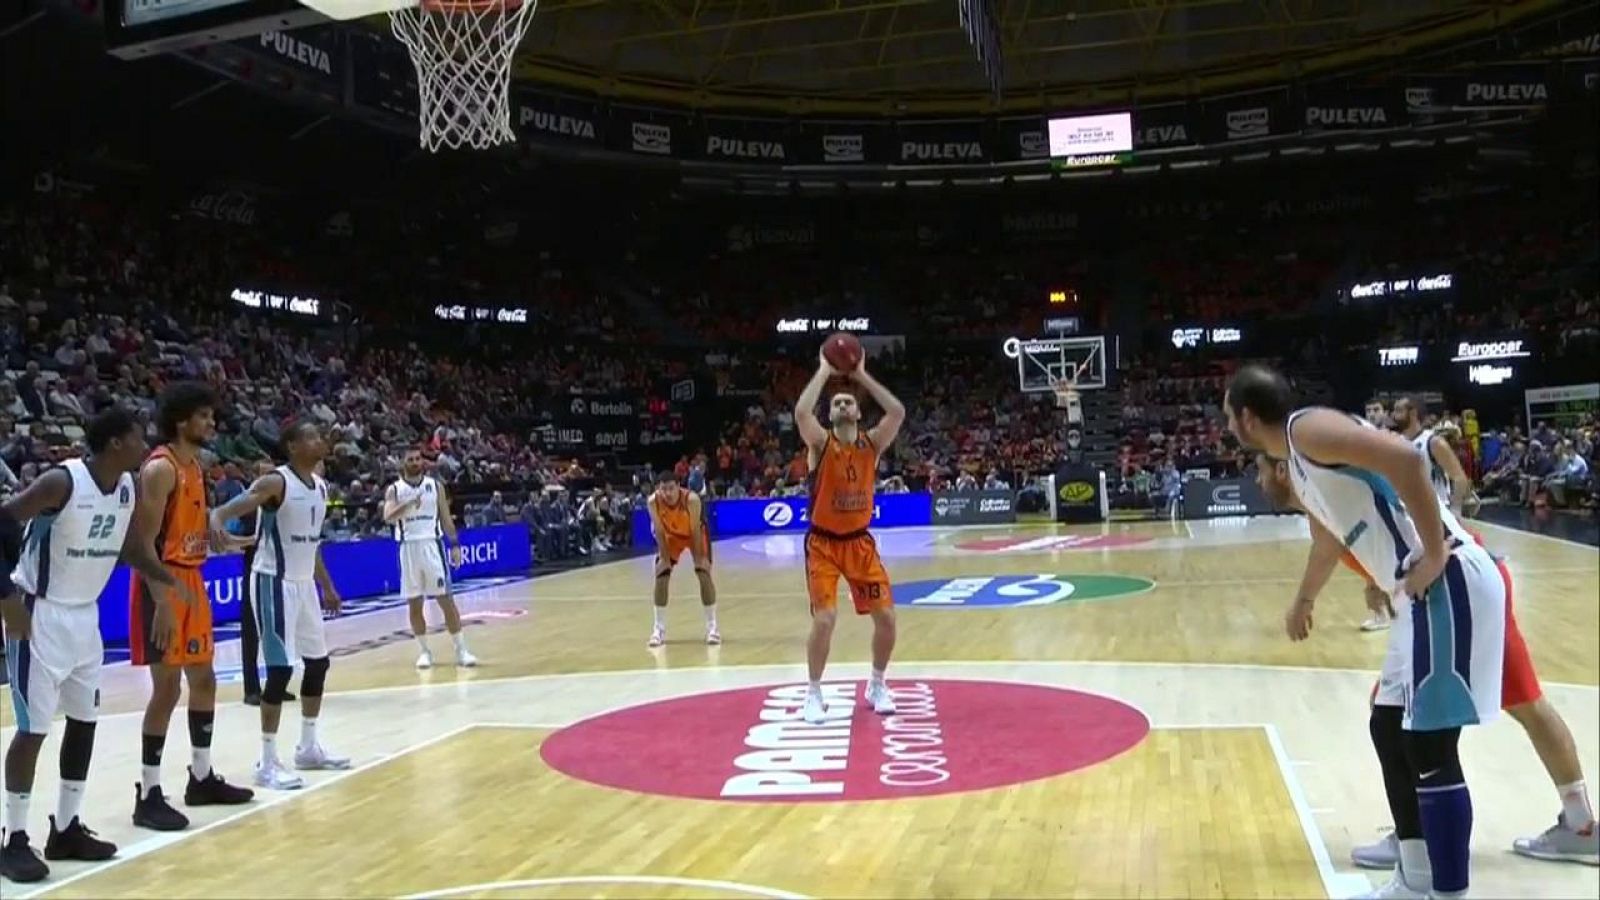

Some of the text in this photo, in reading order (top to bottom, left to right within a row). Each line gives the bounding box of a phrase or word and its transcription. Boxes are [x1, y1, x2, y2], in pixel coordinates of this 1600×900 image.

[1466, 83, 1547, 103] PULEVA
[519, 105, 595, 139] PULEVA
[1306, 105, 1387, 126] PULEVA
[707, 135, 786, 159] PULEVA
[900, 140, 983, 161] PULEVA
[1458, 340, 1523, 357] Europcar
[88, 513, 116, 540] 22
